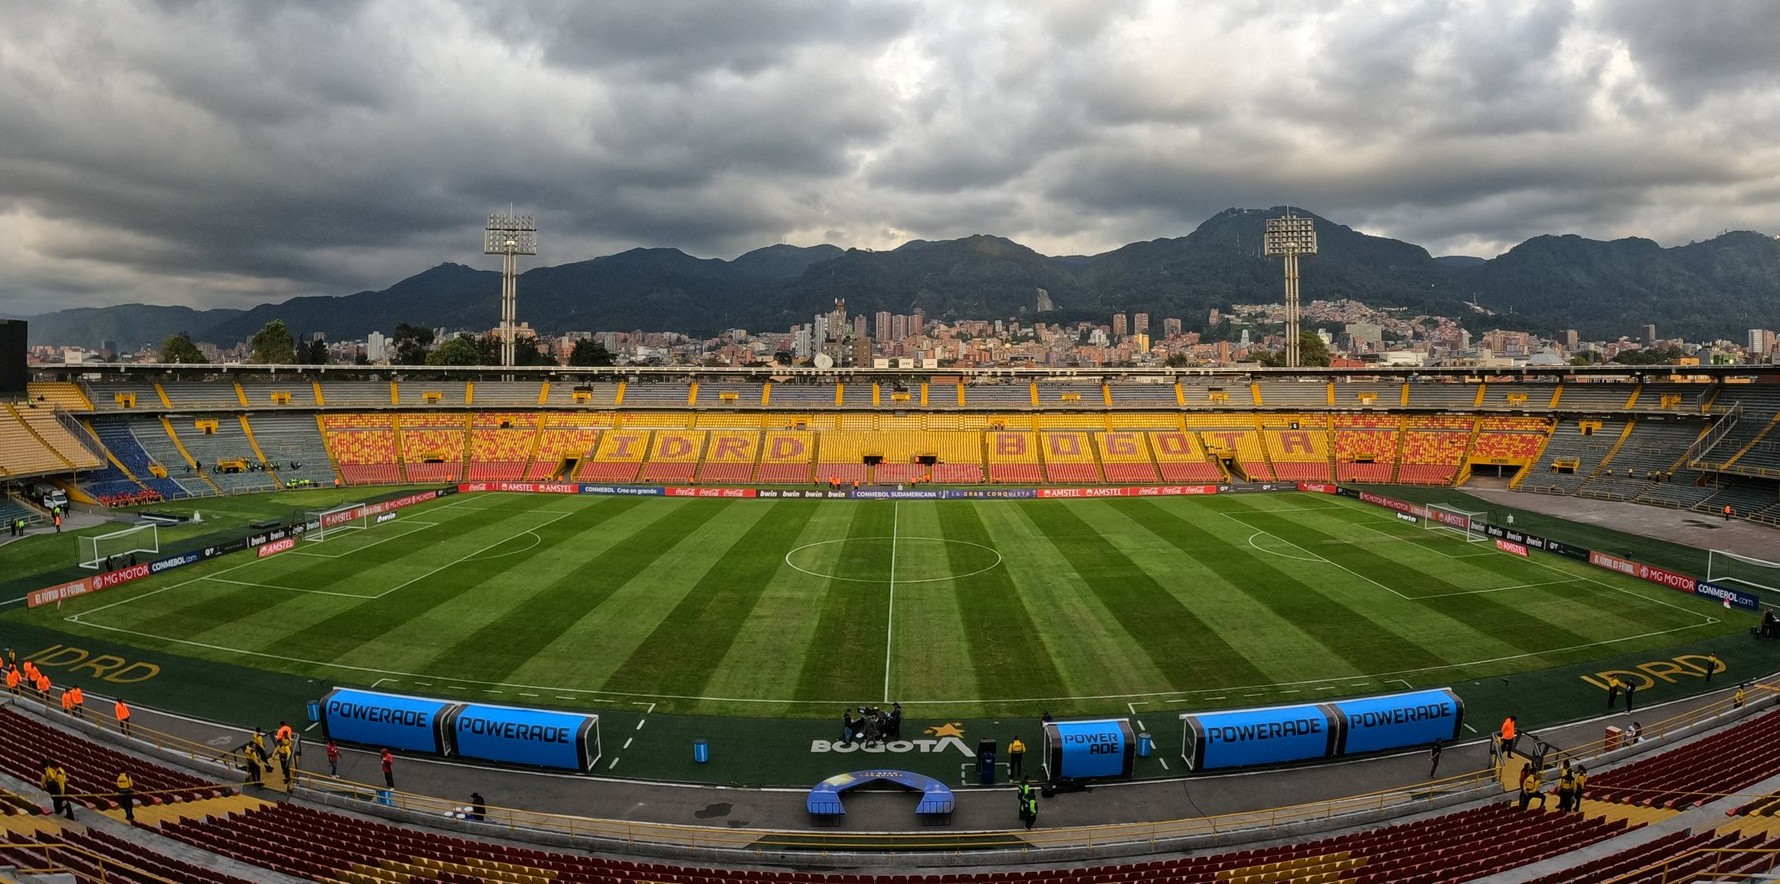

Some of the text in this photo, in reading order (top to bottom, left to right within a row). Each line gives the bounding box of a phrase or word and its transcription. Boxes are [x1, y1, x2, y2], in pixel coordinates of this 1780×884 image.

[508, 483, 534, 492] AMSTEL
[546, 484, 572, 493] AMSTEL
[675, 488, 696, 496] Coca-Cola
[699, 488, 719, 497] Coca-Cola
[723, 489, 744, 497] Coca-Cola
[963, 489, 985, 497] GRAN
[986, 489, 1031, 497] CONQUISTA
[1052, 488, 1081, 497] AMSTEL
[1094, 488, 1122, 496] AMSTEL
[1138, 487, 1159, 495] Coca-Cola
[1185, 486, 1205, 494] Coca-Cola
[1307, 484, 1326, 492] Coca-Cola
[805, 490, 823, 498] bwin
[827, 490, 845, 498] bwin
[856, 490, 937, 498] CONMEBOL SUDAMERICANA
[331, 511, 352, 525] AMSTEL
[377, 511, 396, 523] bwin
[1397, 511, 1417, 523] bwin
[1445, 513, 1465, 527] AMSTEL
[251, 534, 266, 546] bwin
[270, 529, 285, 541] bwin
[1506, 530, 1522, 543] bwin
[1526, 535, 1542, 547] bwin
[267, 539, 294, 554] AMSTEL
[1503, 542, 1528, 557] AMSTEL
[104, 565, 149, 586] MG MOTOR
[1650, 569, 1695, 592] MG MOTOR
[22, 644, 161, 684] IDRD
[1579, 654, 1727, 696] IDRD
[328, 701, 427, 728] POWERADE
[1351, 702, 1451, 730] POWERADE
[458, 716, 570, 744] POWERADE
[1208, 718, 1322, 744] POWERADE
[1064, 732, 1119, 745] POWER
[1089, 743, 1119, 755] ADE
